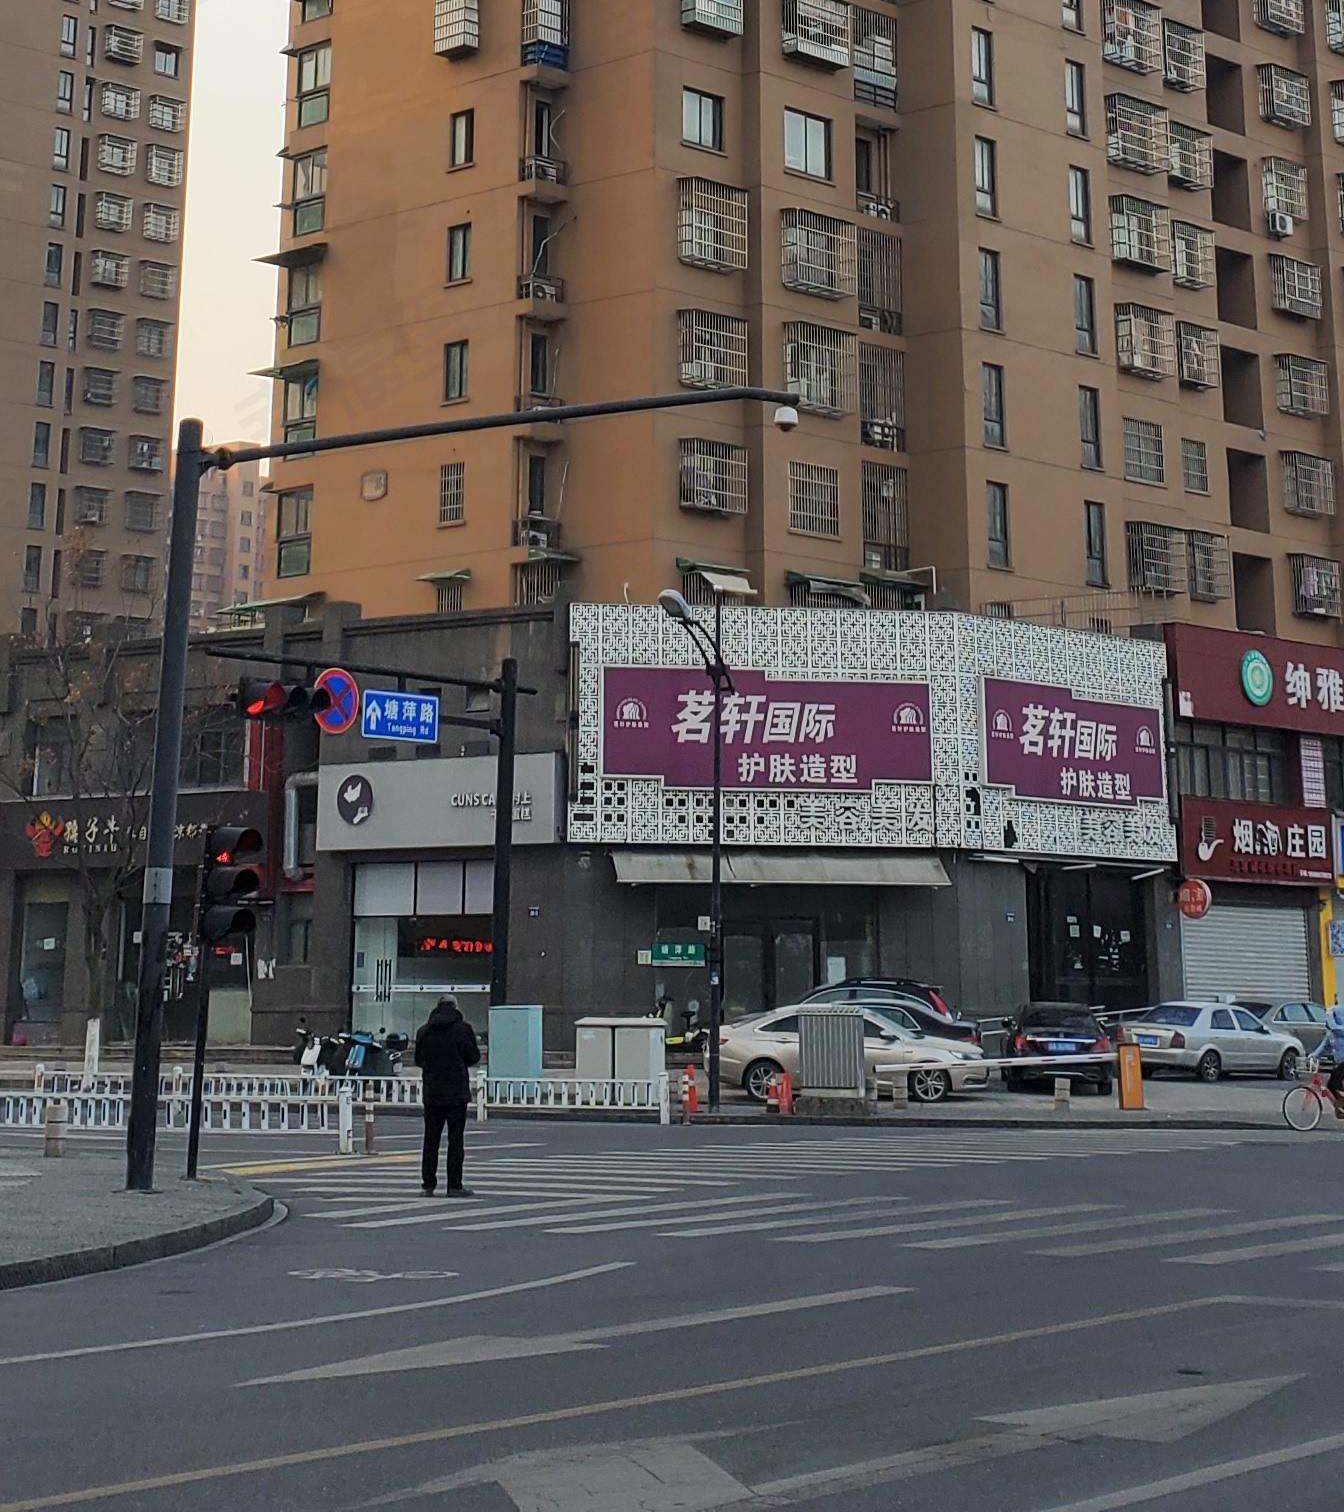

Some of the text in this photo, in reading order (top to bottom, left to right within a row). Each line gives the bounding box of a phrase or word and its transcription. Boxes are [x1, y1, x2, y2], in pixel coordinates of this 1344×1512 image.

[384, 699, 434, 724] 塘萍路
[671, 690, 836, 744] 茗轩国际
[387, 723, 429, 736] Tangping Rd
[1019, 703, 1117, 761] 茗轩国际
[738, 752, 858, 784] 护肤造型
[1060, 767, 1131, 800] 护肤造型
[1233, 818, 1326, 859] 烟酒庄园
